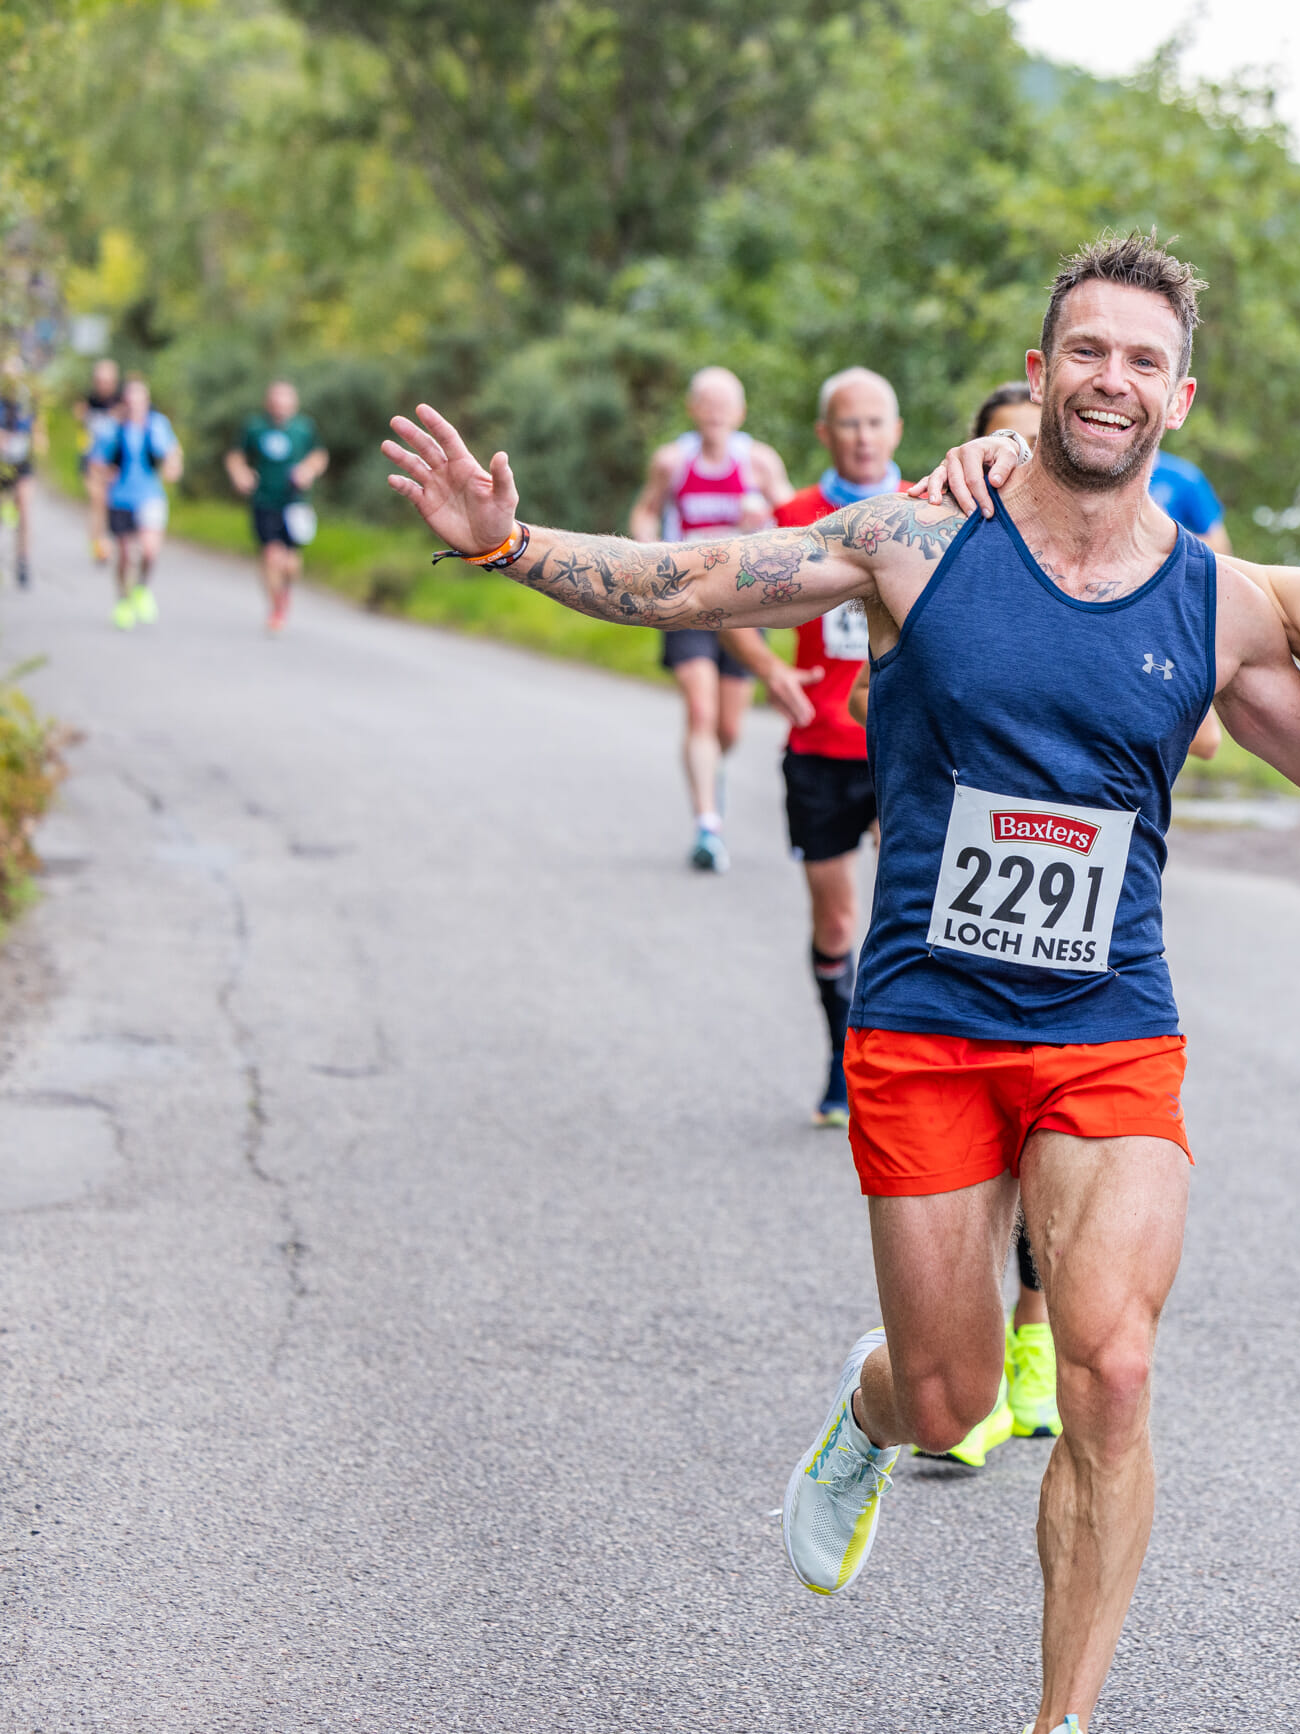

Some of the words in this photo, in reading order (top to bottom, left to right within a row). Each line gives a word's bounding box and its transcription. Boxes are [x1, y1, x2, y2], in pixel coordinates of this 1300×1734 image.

[999, 816, 1091, 849] Baxters
[948, 846, 1104, 932] 2291
[943, 918, 1023, 955] LOCH
[1032, 935, 1097, 963] NESS
